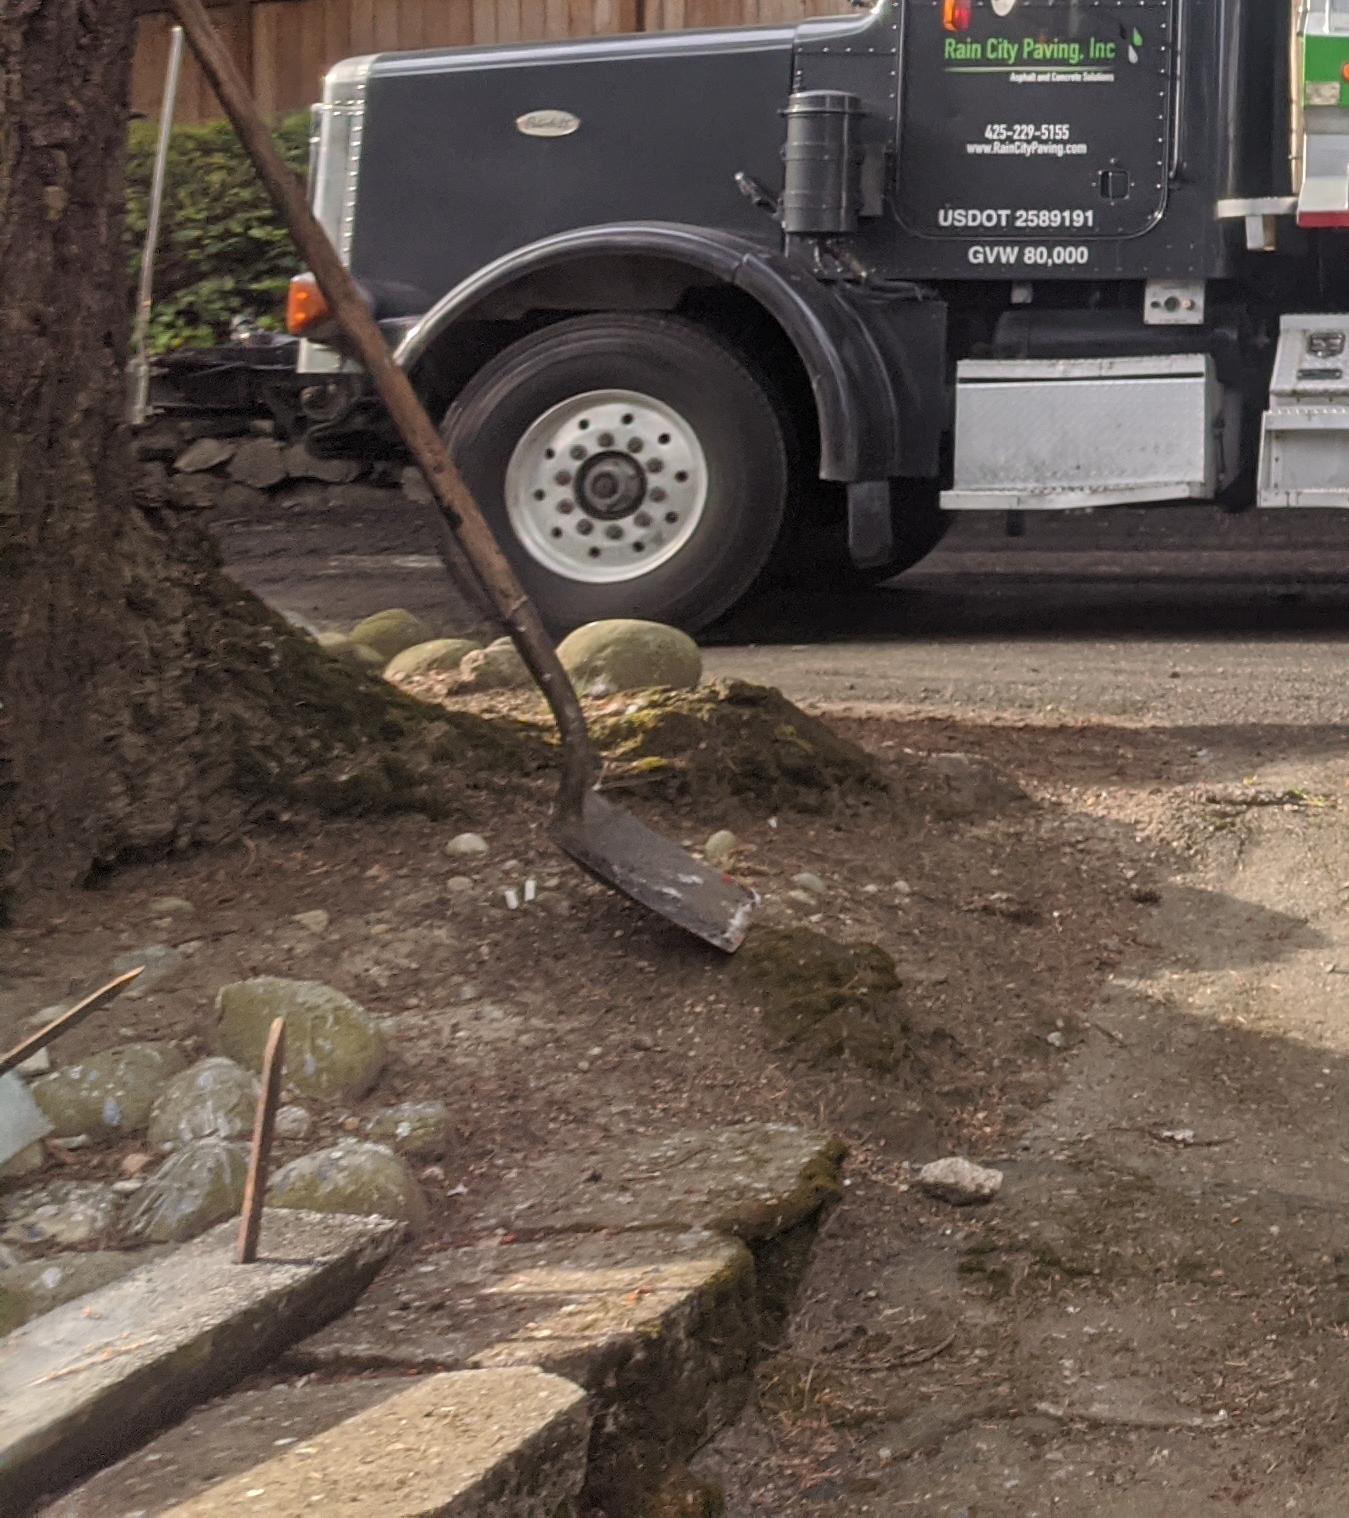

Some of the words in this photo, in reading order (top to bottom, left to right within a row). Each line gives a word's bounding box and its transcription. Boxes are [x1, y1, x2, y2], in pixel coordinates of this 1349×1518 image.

[944, 37, 982, 60] Rain
[986, 37, 1018, 65] City
[1089, 37, 1116, 59] Inc
[984, 123, 1070, 140] 425-229-5155
[966, 141, 1088, 158] www.RainCityPaving.com
[938, 209, 1011, 227] USDOT
[1014, 209, 1094, 227] 2589191
[967, 245, 1019, 264] GVW
[1023, 245, 1089, 267] 80,000
